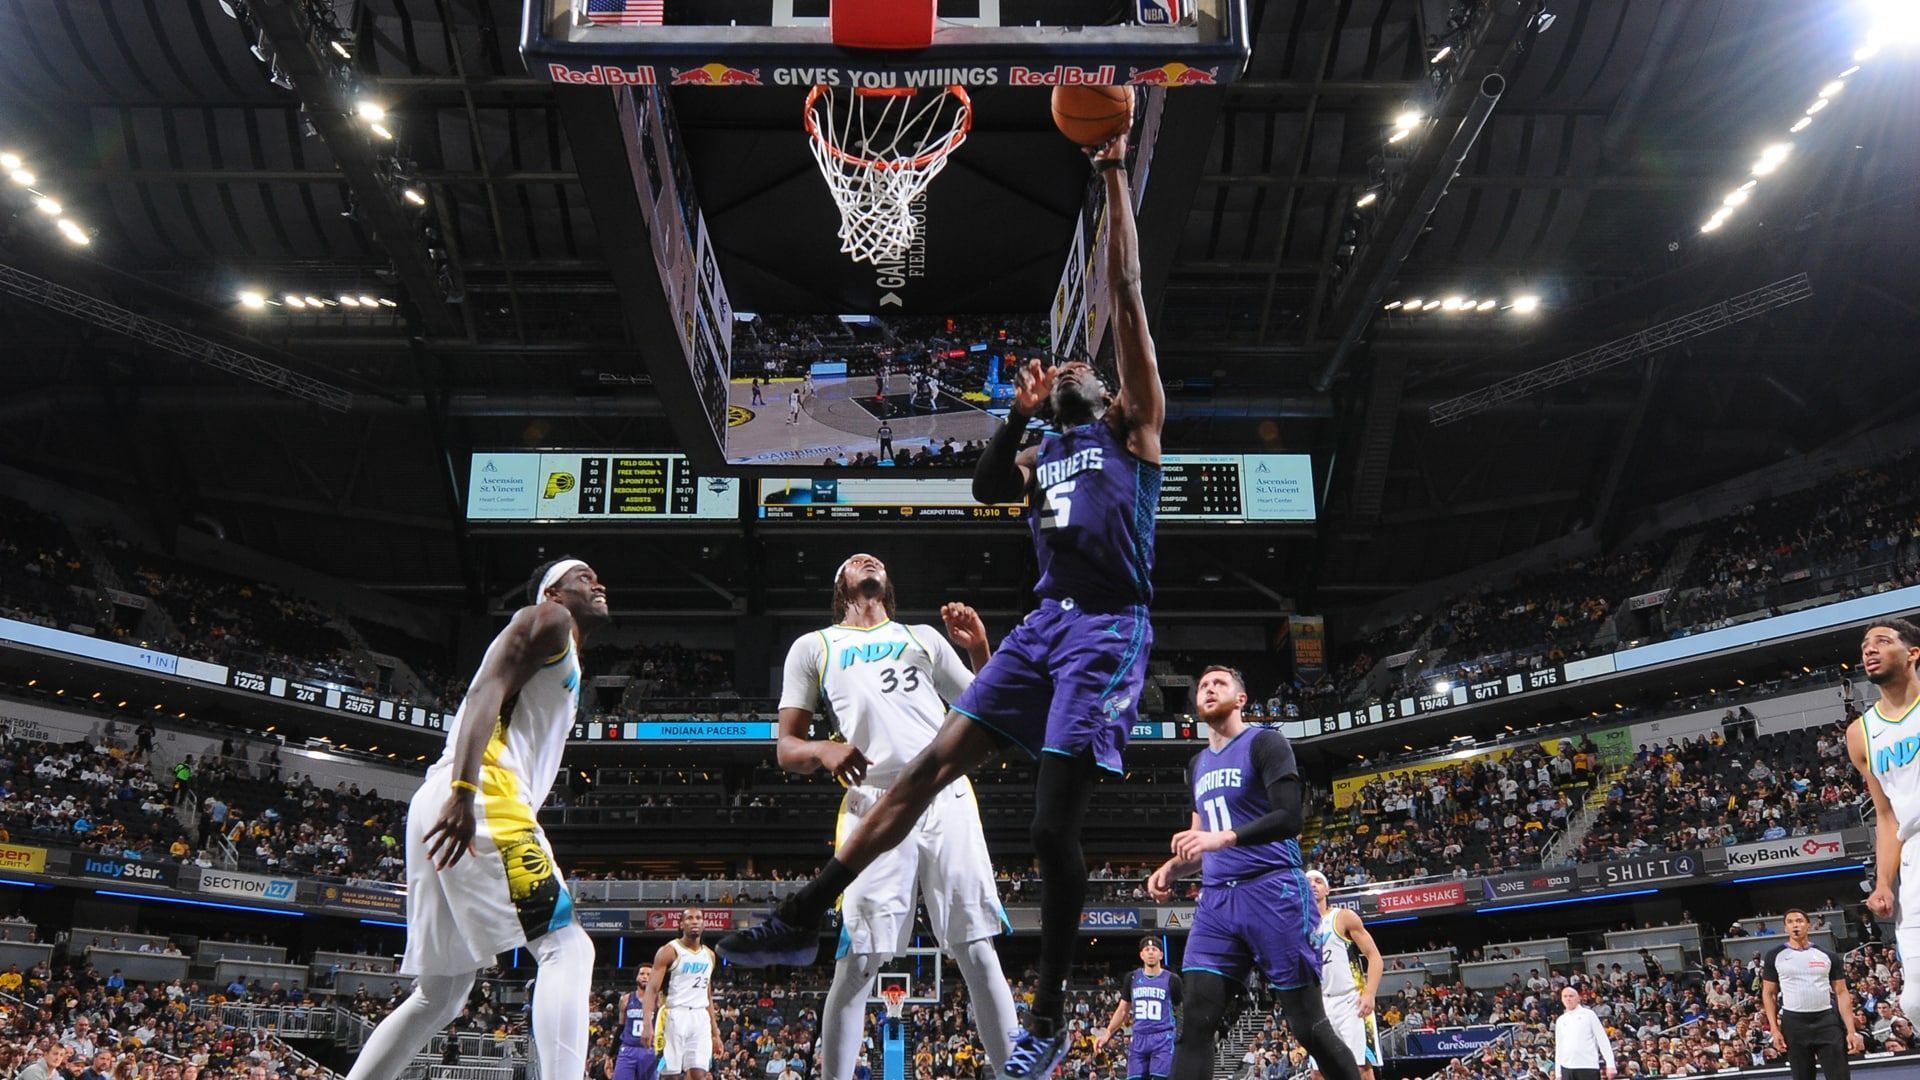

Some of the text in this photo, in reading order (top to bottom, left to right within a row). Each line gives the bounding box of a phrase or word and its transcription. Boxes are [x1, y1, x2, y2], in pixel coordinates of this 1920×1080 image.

[1145, 9, 1164, 21] NBA
[773, 67, 998, 89] GIVES YOU WIIINGS
[1036, 447, 1104, 489] ORNETS
[1041, 480, 1076, 528] 5
[974, 508, 1000, 517] $1,910
[155, 657, 168, 667] IN
[840, 640, 908, 671] INDY
[233, 676, 265, 691] 12/28
[880, 666, 919, 694] 33
[1531, 673, 1557, 687] 5/15
[296, 690, 315, 702] 2/4
[1475, 687, 1499, 699] 6/11
[345, 700, 375, 714] 25/57
[1419, 697, 1449, 711] 19/46
[398, 711, 406, 721] 6
[1355, 715, 1367, 725] 10
[1388, 709, 1395, 718] 2
[428, 717, 440, 728] 16
[1323, 721, 1336, 732] 30
[575, 729, 583, 738] 5
[609, 729, 617, 738] 0
[661, 726, 747, 736] INDIANA PACERS
[1183, 728, 1190, 738] 0
[1606, 730, 1625, 741] 101
[1877, 732, 1920, 775] IND
[1336, 781, 1351, 790] 101
[1203, 795, 1233, 833] 11
[1728, 847, 1801, 866] KeyBank
[1606, 858, 1688, 882] SHIFT 4
[203, 875, 289, 896] SECTION 127
[1380, 894, 1414, 907] STEAK
[1422, 889, 1459, 902] SHAKE
[704, 911, 729, 920] FEVER
[692, 976, 708, 989] 23
[1132, 986, 1166, 1000] HORNETS
[1135, 999, 1162, 1020] 30
